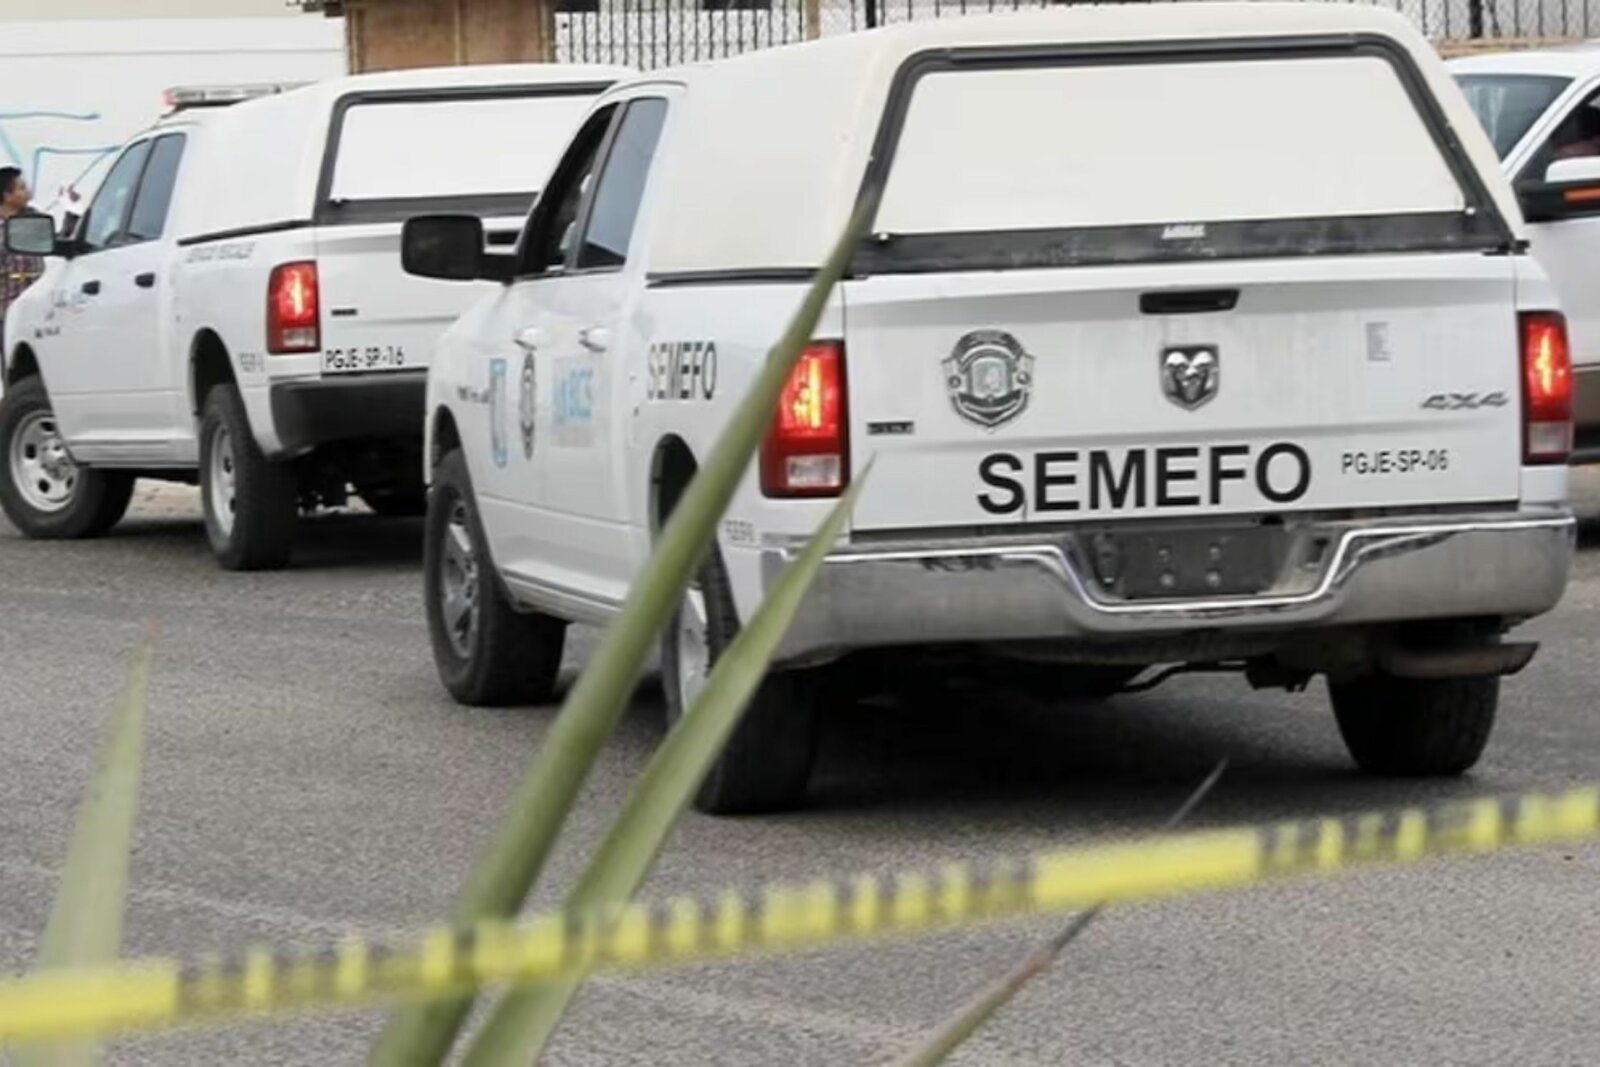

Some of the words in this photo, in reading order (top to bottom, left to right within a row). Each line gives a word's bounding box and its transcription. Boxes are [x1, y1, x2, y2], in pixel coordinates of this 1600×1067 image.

[649, 342, 717, 400] SEMEFO
[977, 441, 1312, 514] SEMEFO
[1341, 449, 1448, 476] PGJE-SP-06
